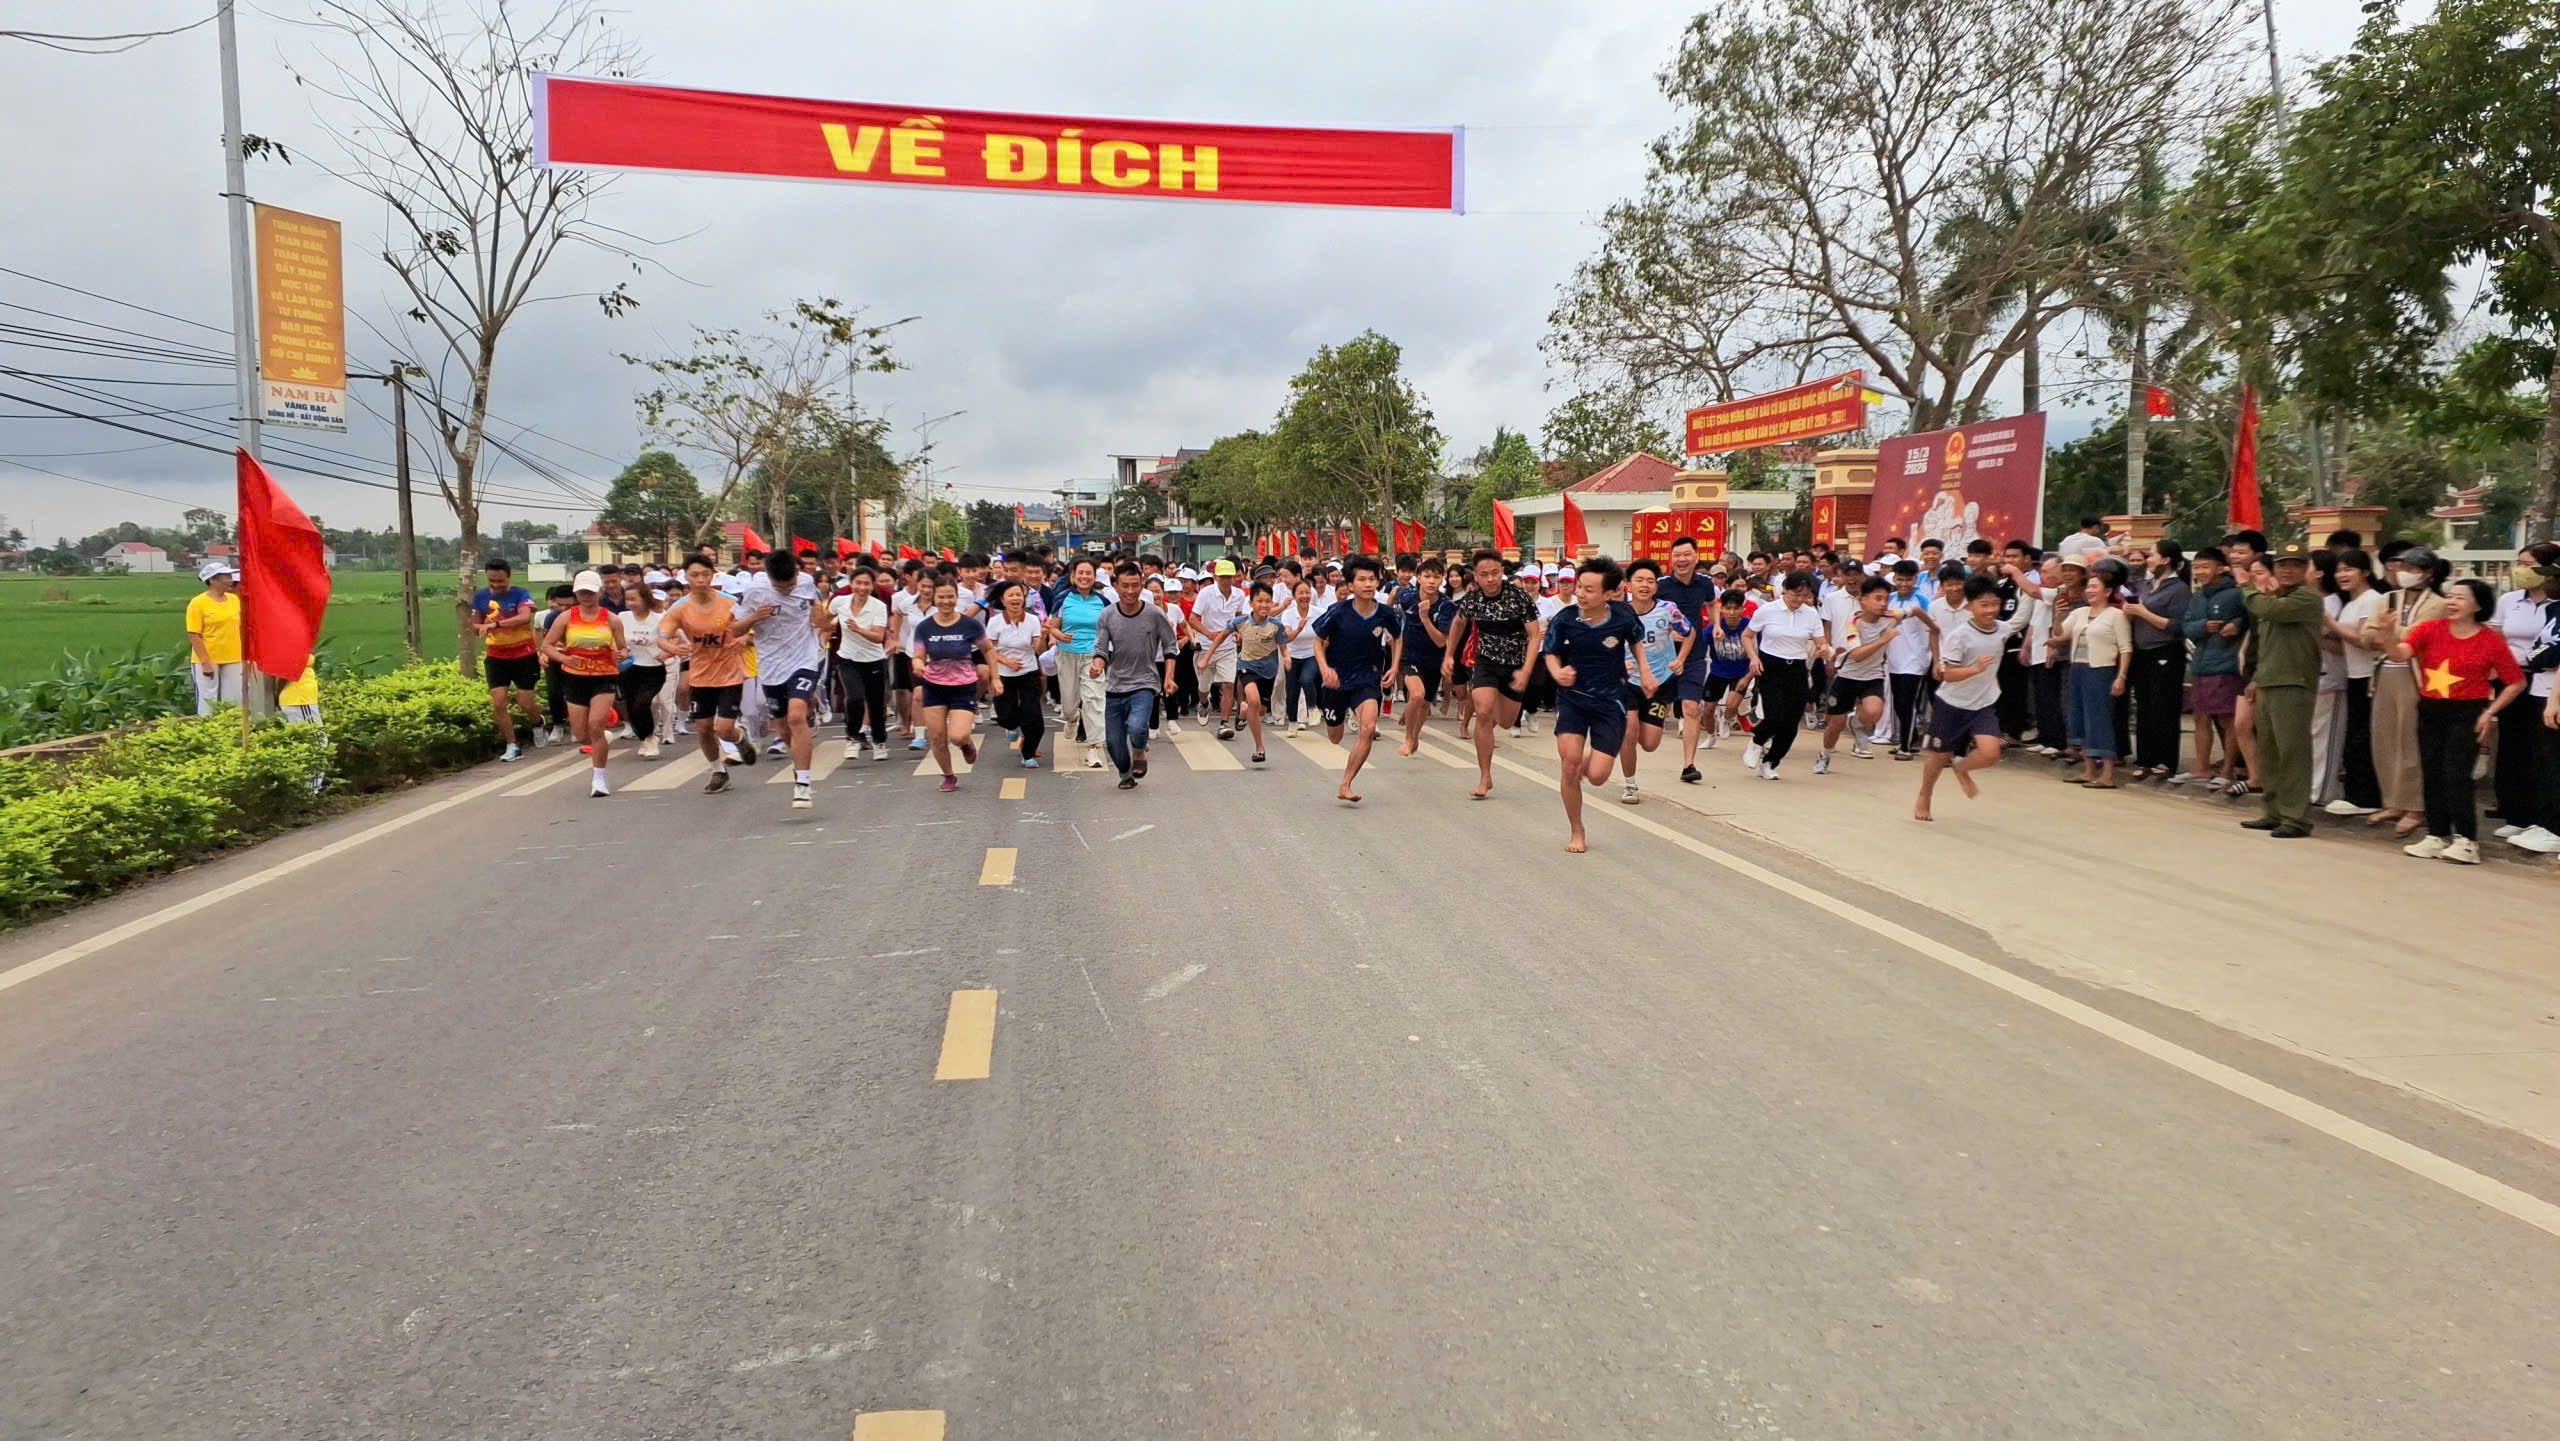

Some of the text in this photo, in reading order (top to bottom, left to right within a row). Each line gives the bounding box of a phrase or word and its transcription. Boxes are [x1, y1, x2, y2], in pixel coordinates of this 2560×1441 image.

[821, 114, 1218, 191] VỀ ĐÍCH
[272, 386, 338, 404] NAM HÀ
[284, 401, 327, 413] VÀNG BẠC
[1907, 447, 1930, 460] 15/3
[769, 605, 781, 616] 27
[1642, 630, 1656, 644] 6
[796, 677, 812, 691] 27
[1325, 708, 1337, 721] 24
[1648, 702, 1665, 719] 26
